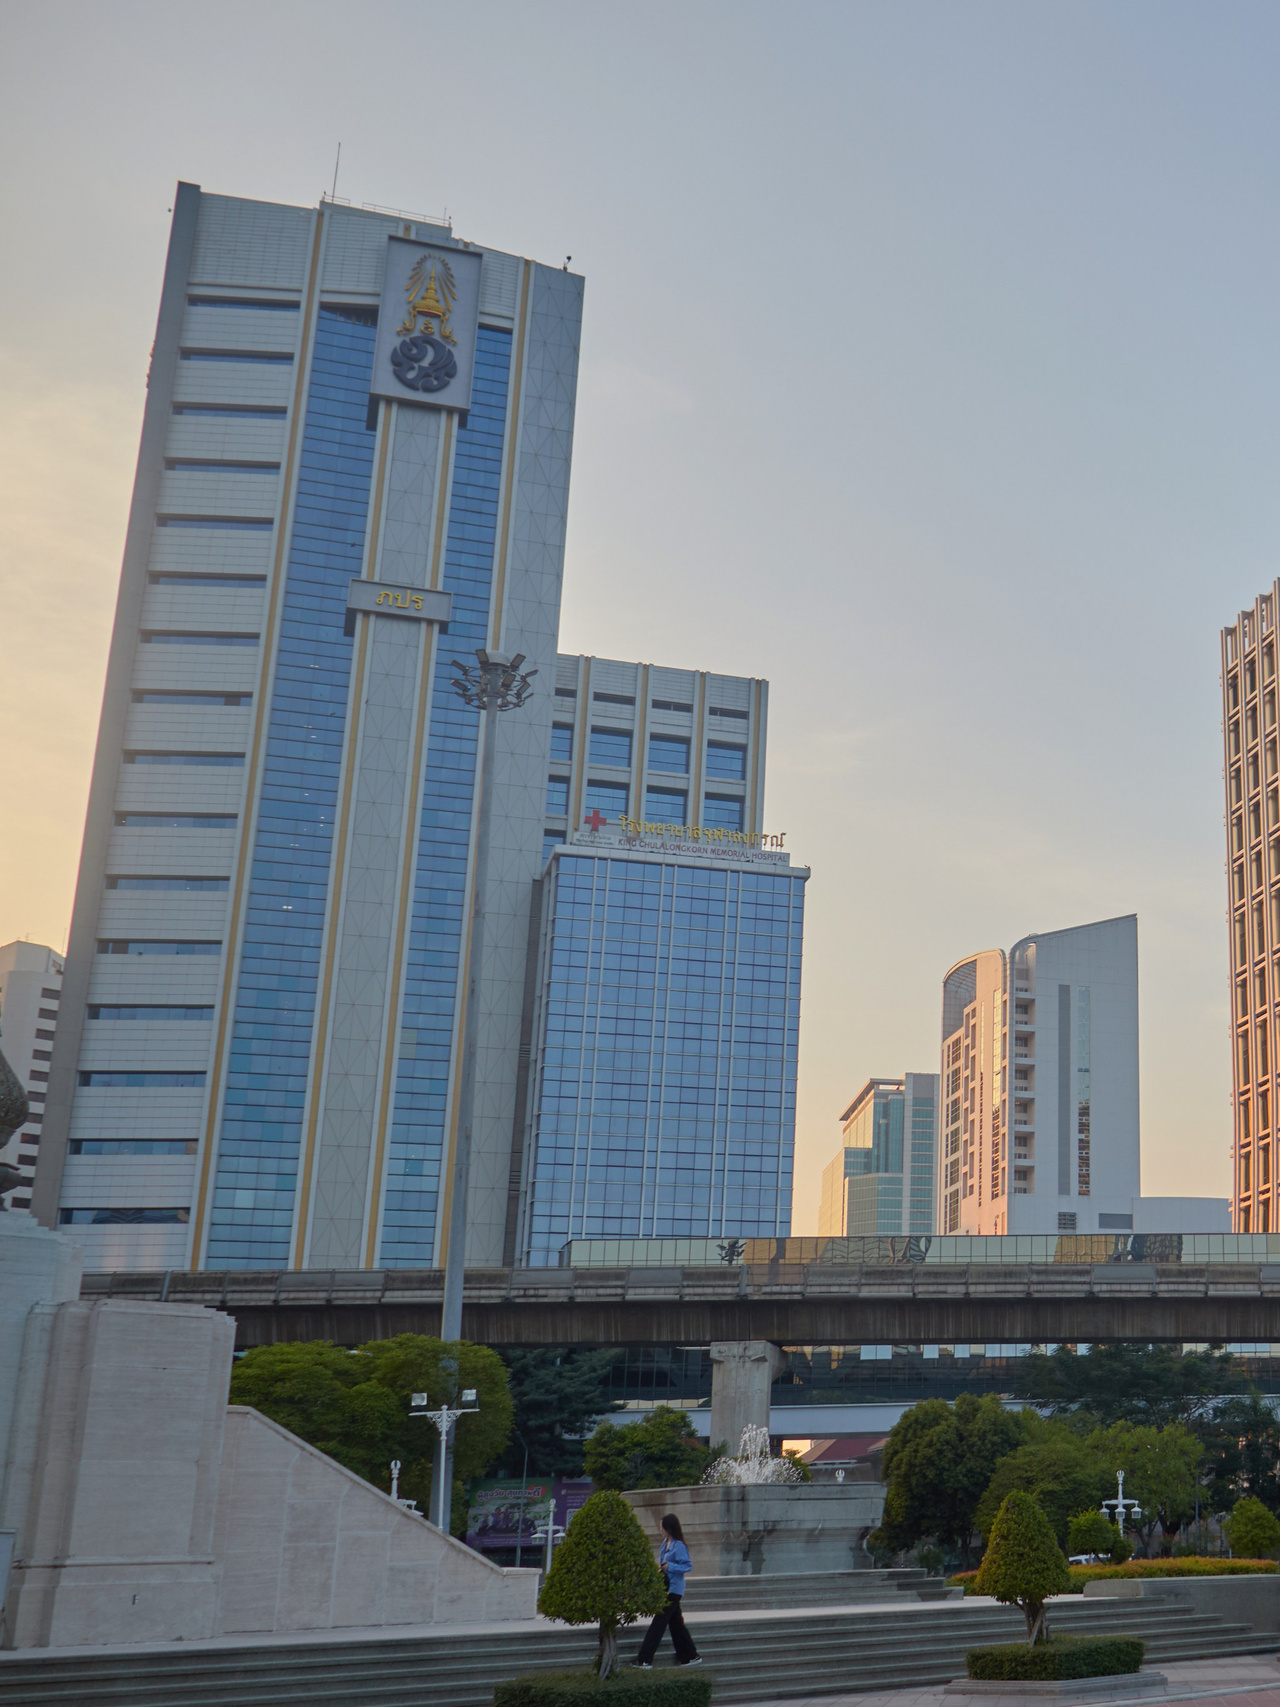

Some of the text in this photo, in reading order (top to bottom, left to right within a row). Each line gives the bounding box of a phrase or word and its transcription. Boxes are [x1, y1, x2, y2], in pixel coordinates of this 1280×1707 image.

[376, 589, 424, 611] ภปร
[618, 814, 787, 848] โรงพยาบาลจุฬาลงกรณ์
[618, 838, 637, 848] KING
[639, 840, 708, 855] CHULALONGKORN
[710, 847, 750, 859] MEMORIAL
[752, 851, 787, 863] HOSPITAL
